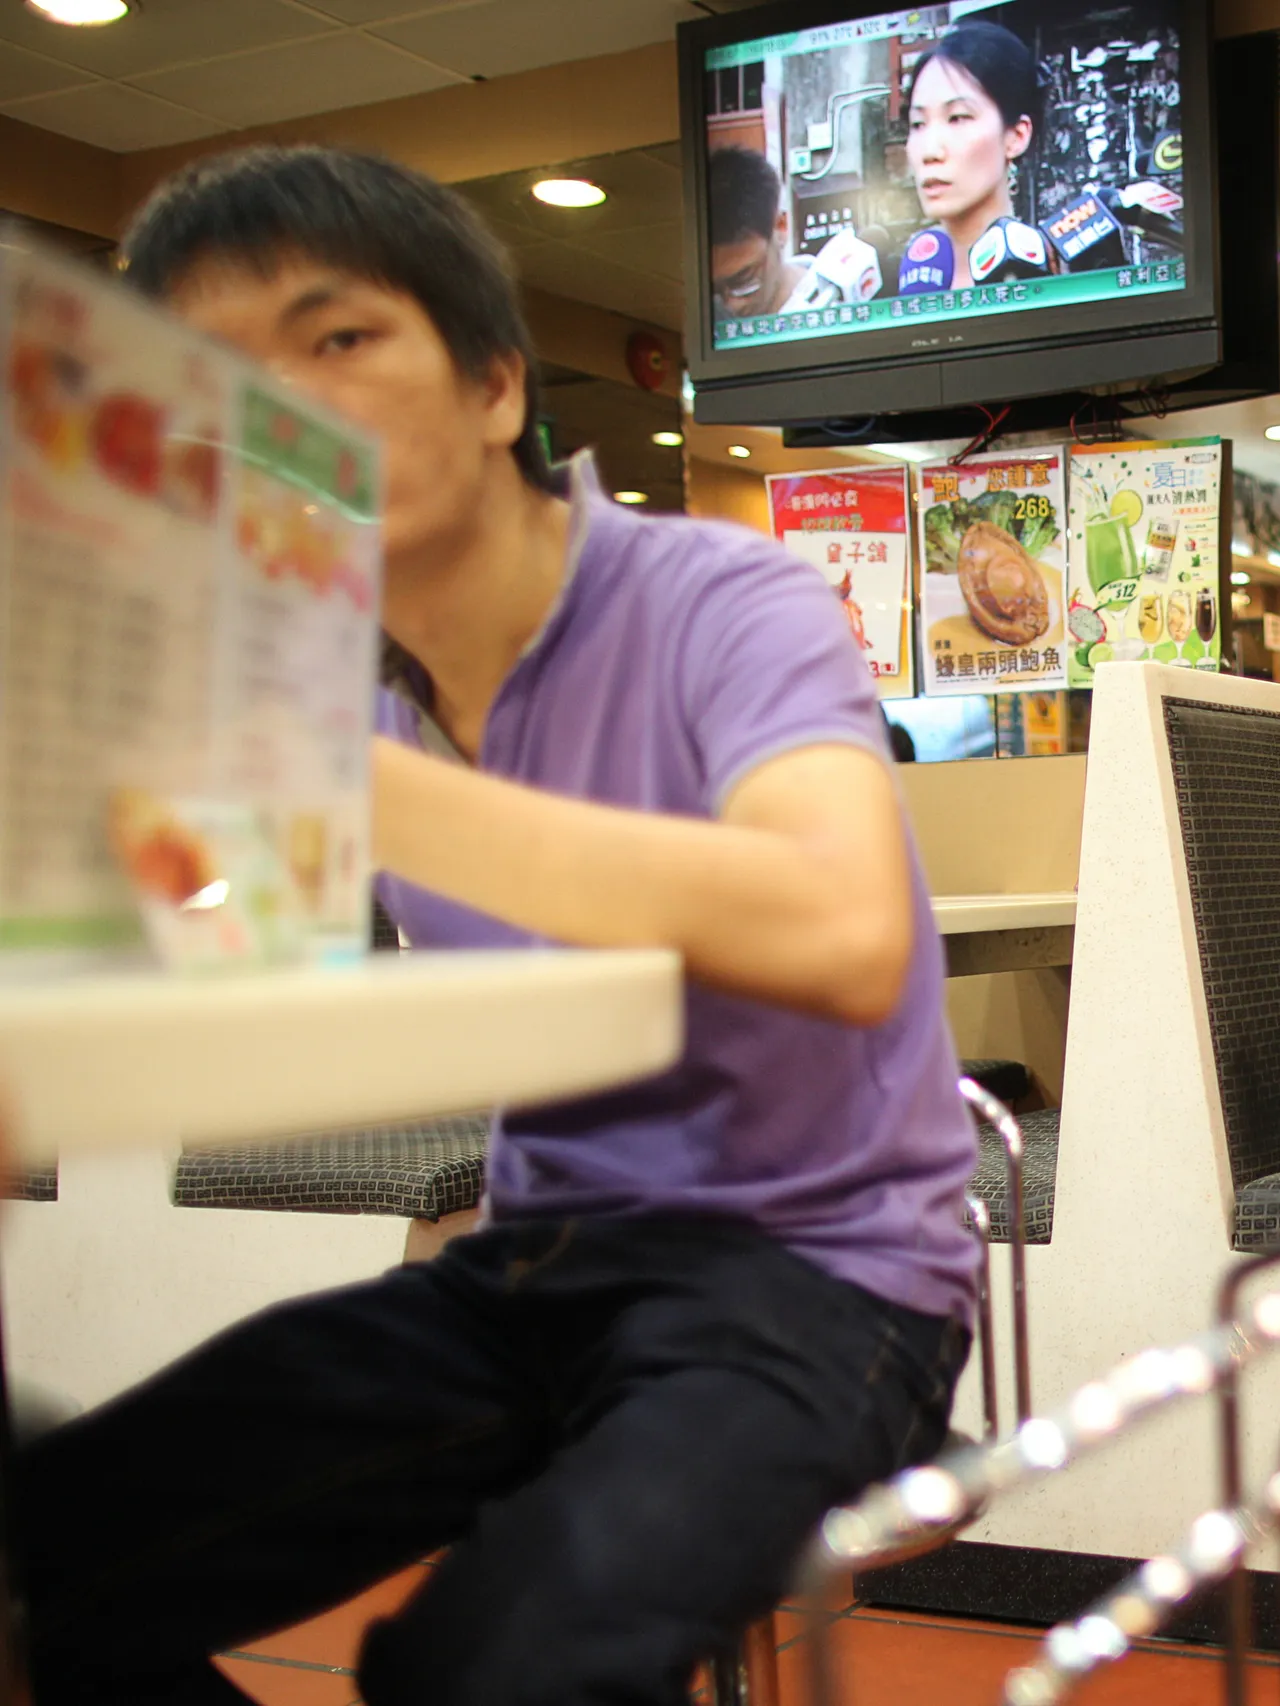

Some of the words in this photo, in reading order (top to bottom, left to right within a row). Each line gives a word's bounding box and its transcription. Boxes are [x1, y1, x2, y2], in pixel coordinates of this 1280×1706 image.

[1049, 199, 1097, 238] now
[1116, 583, 1137, 598] $12
[936, 647, 1061, 678] 蠔皇兩頭鮑魚
